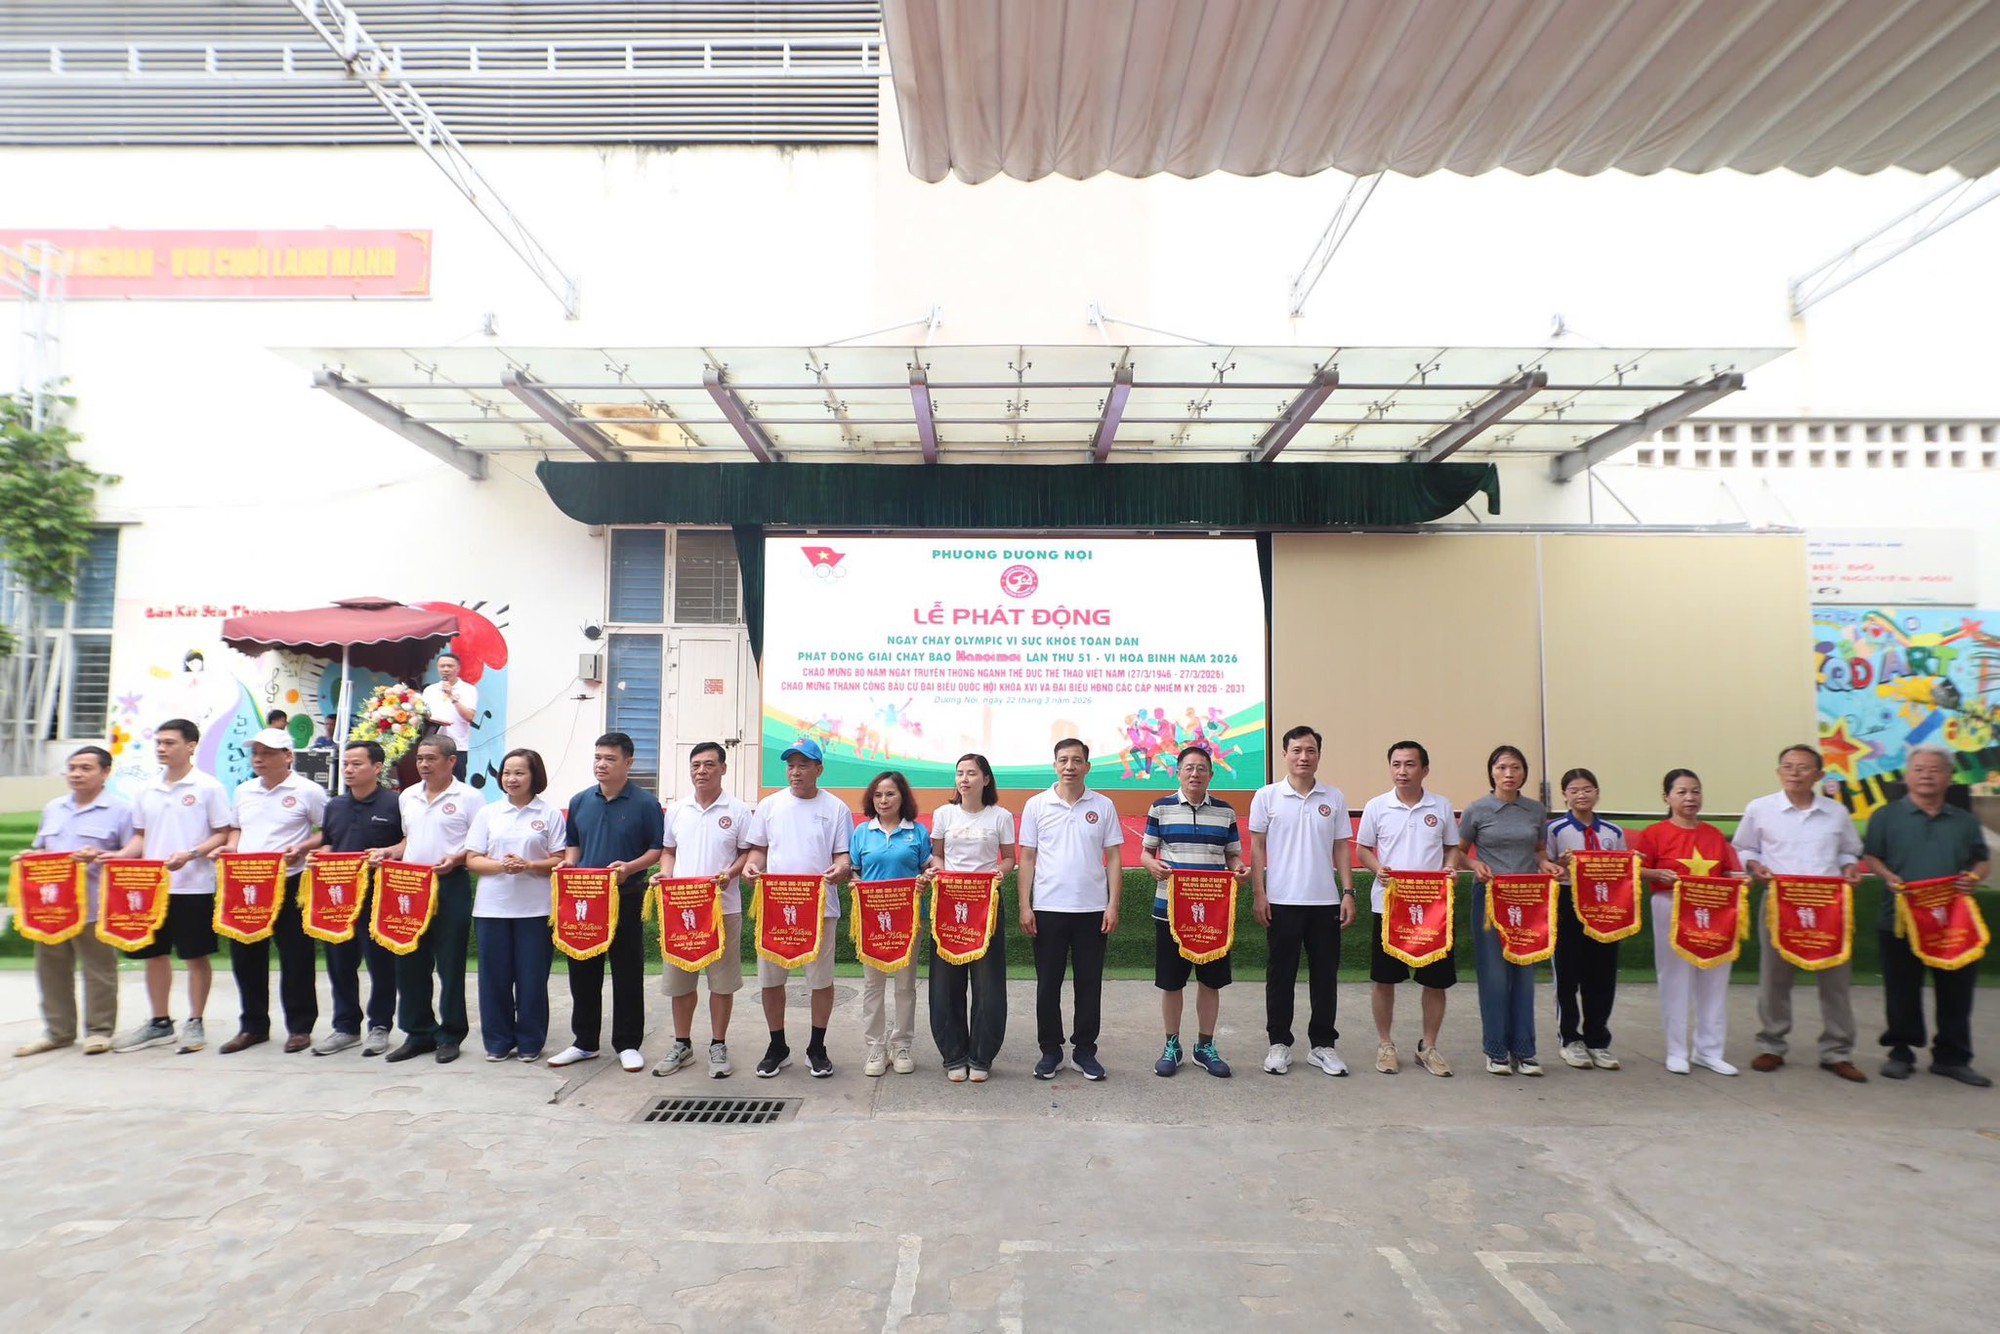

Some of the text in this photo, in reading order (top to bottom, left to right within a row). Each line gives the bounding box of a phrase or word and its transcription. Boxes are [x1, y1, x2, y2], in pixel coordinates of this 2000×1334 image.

[913, 600, 1111, 630] LỄ PHÁT ĐỘNG
[954, 635, 1003, 646] OLYMPIC
[1078, 652, 1091, 663] 51
[1210, 653, 1239, 664] 2026
[1024, 682, 1038, 692] XVI
[1196, 683, 1218, 694] 2026
[1225, 683, 1245, 694] 2031
[1006, 696, 1016, 704] 22
[1072, 696, 1093, 704] 2026
